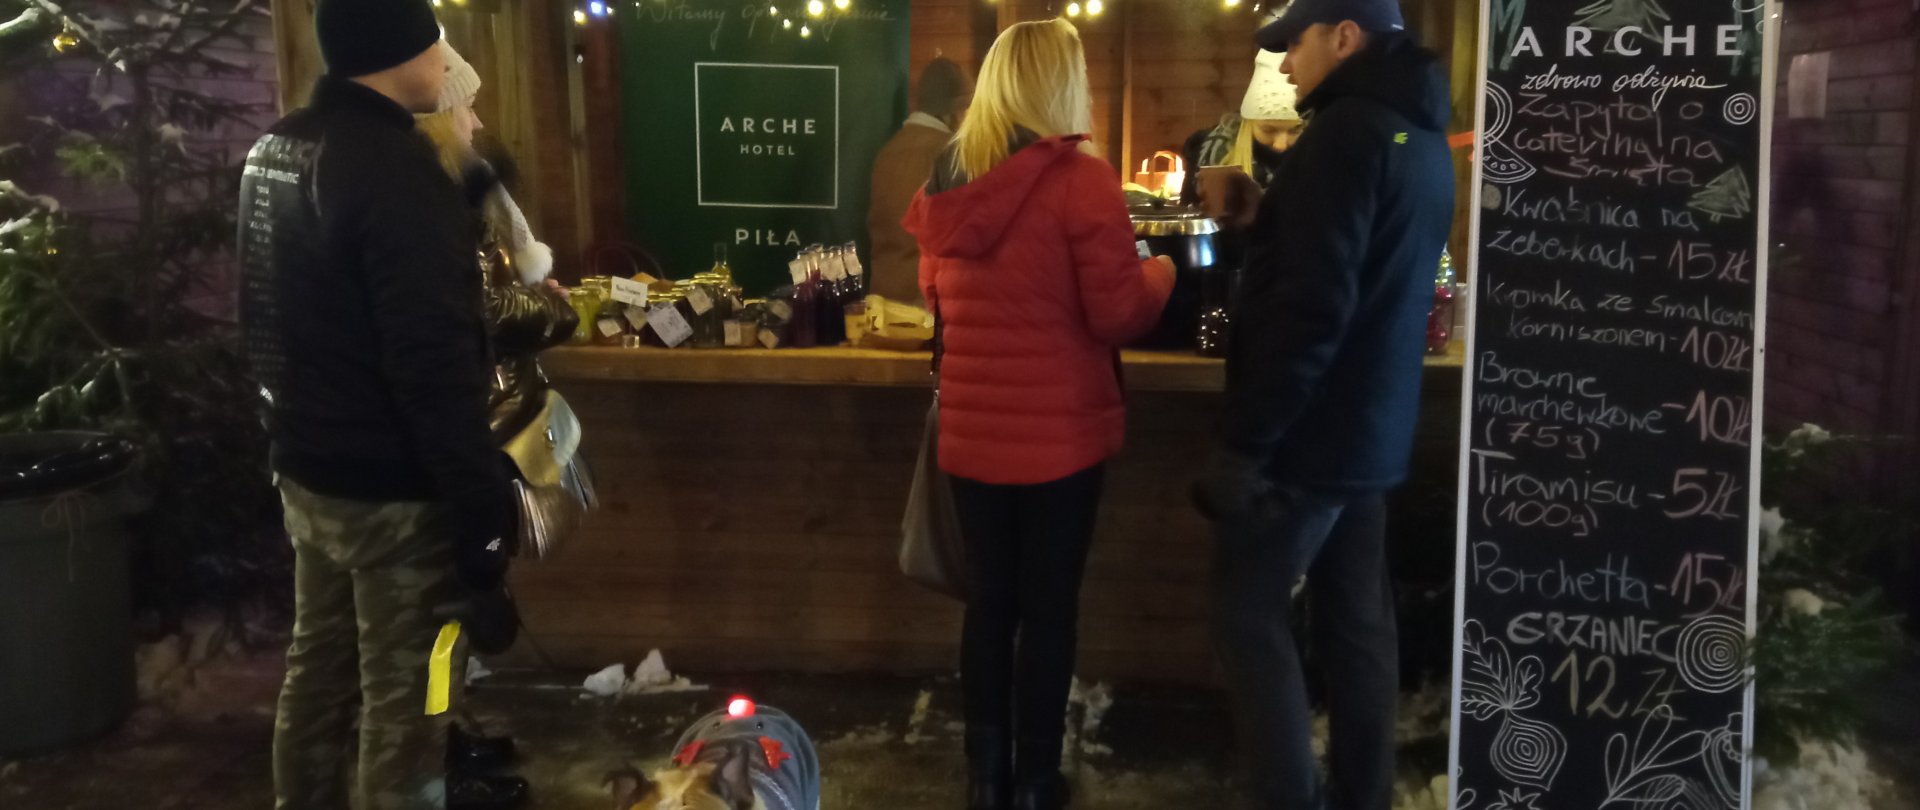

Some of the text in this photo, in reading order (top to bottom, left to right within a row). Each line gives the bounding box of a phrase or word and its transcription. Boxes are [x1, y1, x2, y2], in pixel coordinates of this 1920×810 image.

[1511, 24, 1743, 57] ARCHE
[1520, 63, 1728, 112] zdrowo odżywia
[720, 116, 816, 135] ARCHE
[1517, 92, 1704, 147] Zapytaj o
[740, 144, 796, 156] HOTEL
[1671, 138, 1723, 163] na
[735, 228, 801, 246] PIŁA
[1662, 207, 1700, 231] na
[1471, 448, 1640, 510] Tiramisu
[1472, 541, 1649, 609] Porchetta
[1506, 611, 1681, 664] GRZANIEC
[1551, 648, 1628, 719] 12
